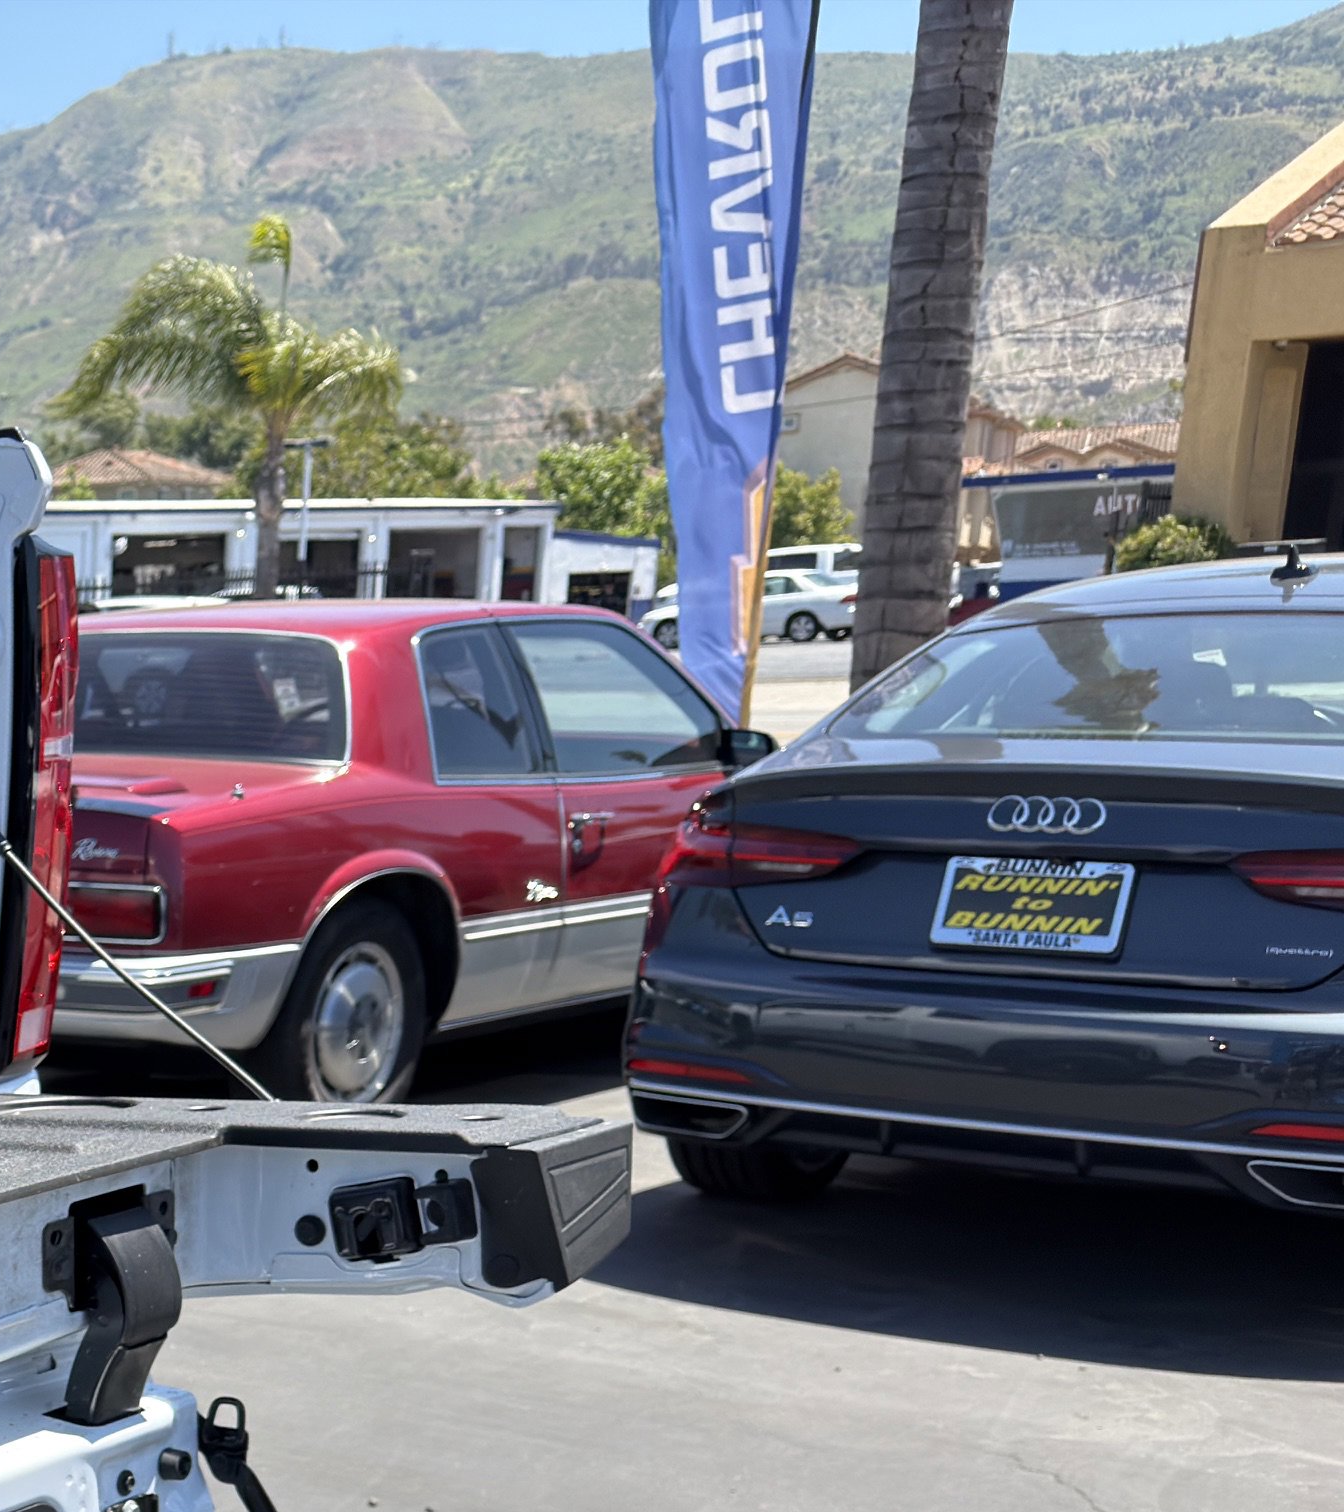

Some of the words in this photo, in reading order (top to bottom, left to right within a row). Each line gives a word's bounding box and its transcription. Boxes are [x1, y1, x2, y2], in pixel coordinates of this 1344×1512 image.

[1093, 493, 1142, 517] AUT
[954, 874, 1120, 897] RUNNIN'
[1011, 895, 1054, 911] to
[764, 904, 814, 928] A5
[945, 910, 1104, 935] BUNNIN
[973, 931, 1018, 945] SANTA
[1024, 933, 1073, 948] PAULA
